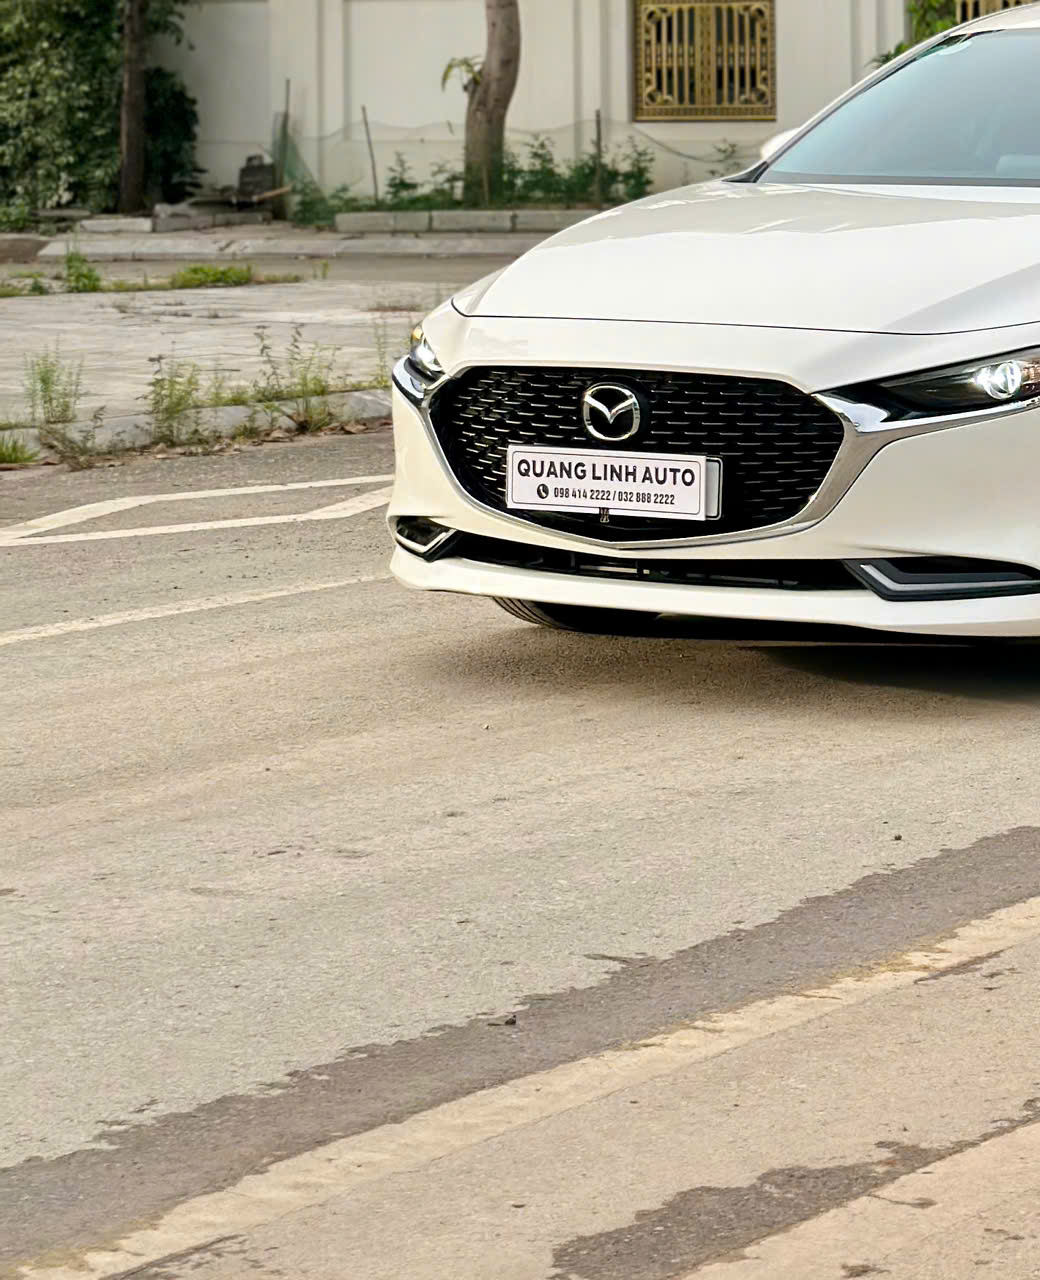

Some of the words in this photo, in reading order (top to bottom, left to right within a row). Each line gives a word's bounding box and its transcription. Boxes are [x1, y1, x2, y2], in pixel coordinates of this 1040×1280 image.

[517, 459, 587, 480] QUANG
[592, 463, 637, 483] LINH
[641, 466, 696, 487] AUTO
[553, 487, 570, 498] 098
[571, 488, 588, 499] 414
[590, 489, 611, 501] 2222
[618, 491, 634, 503] 032
[653, 493, 675, 505] 2222
